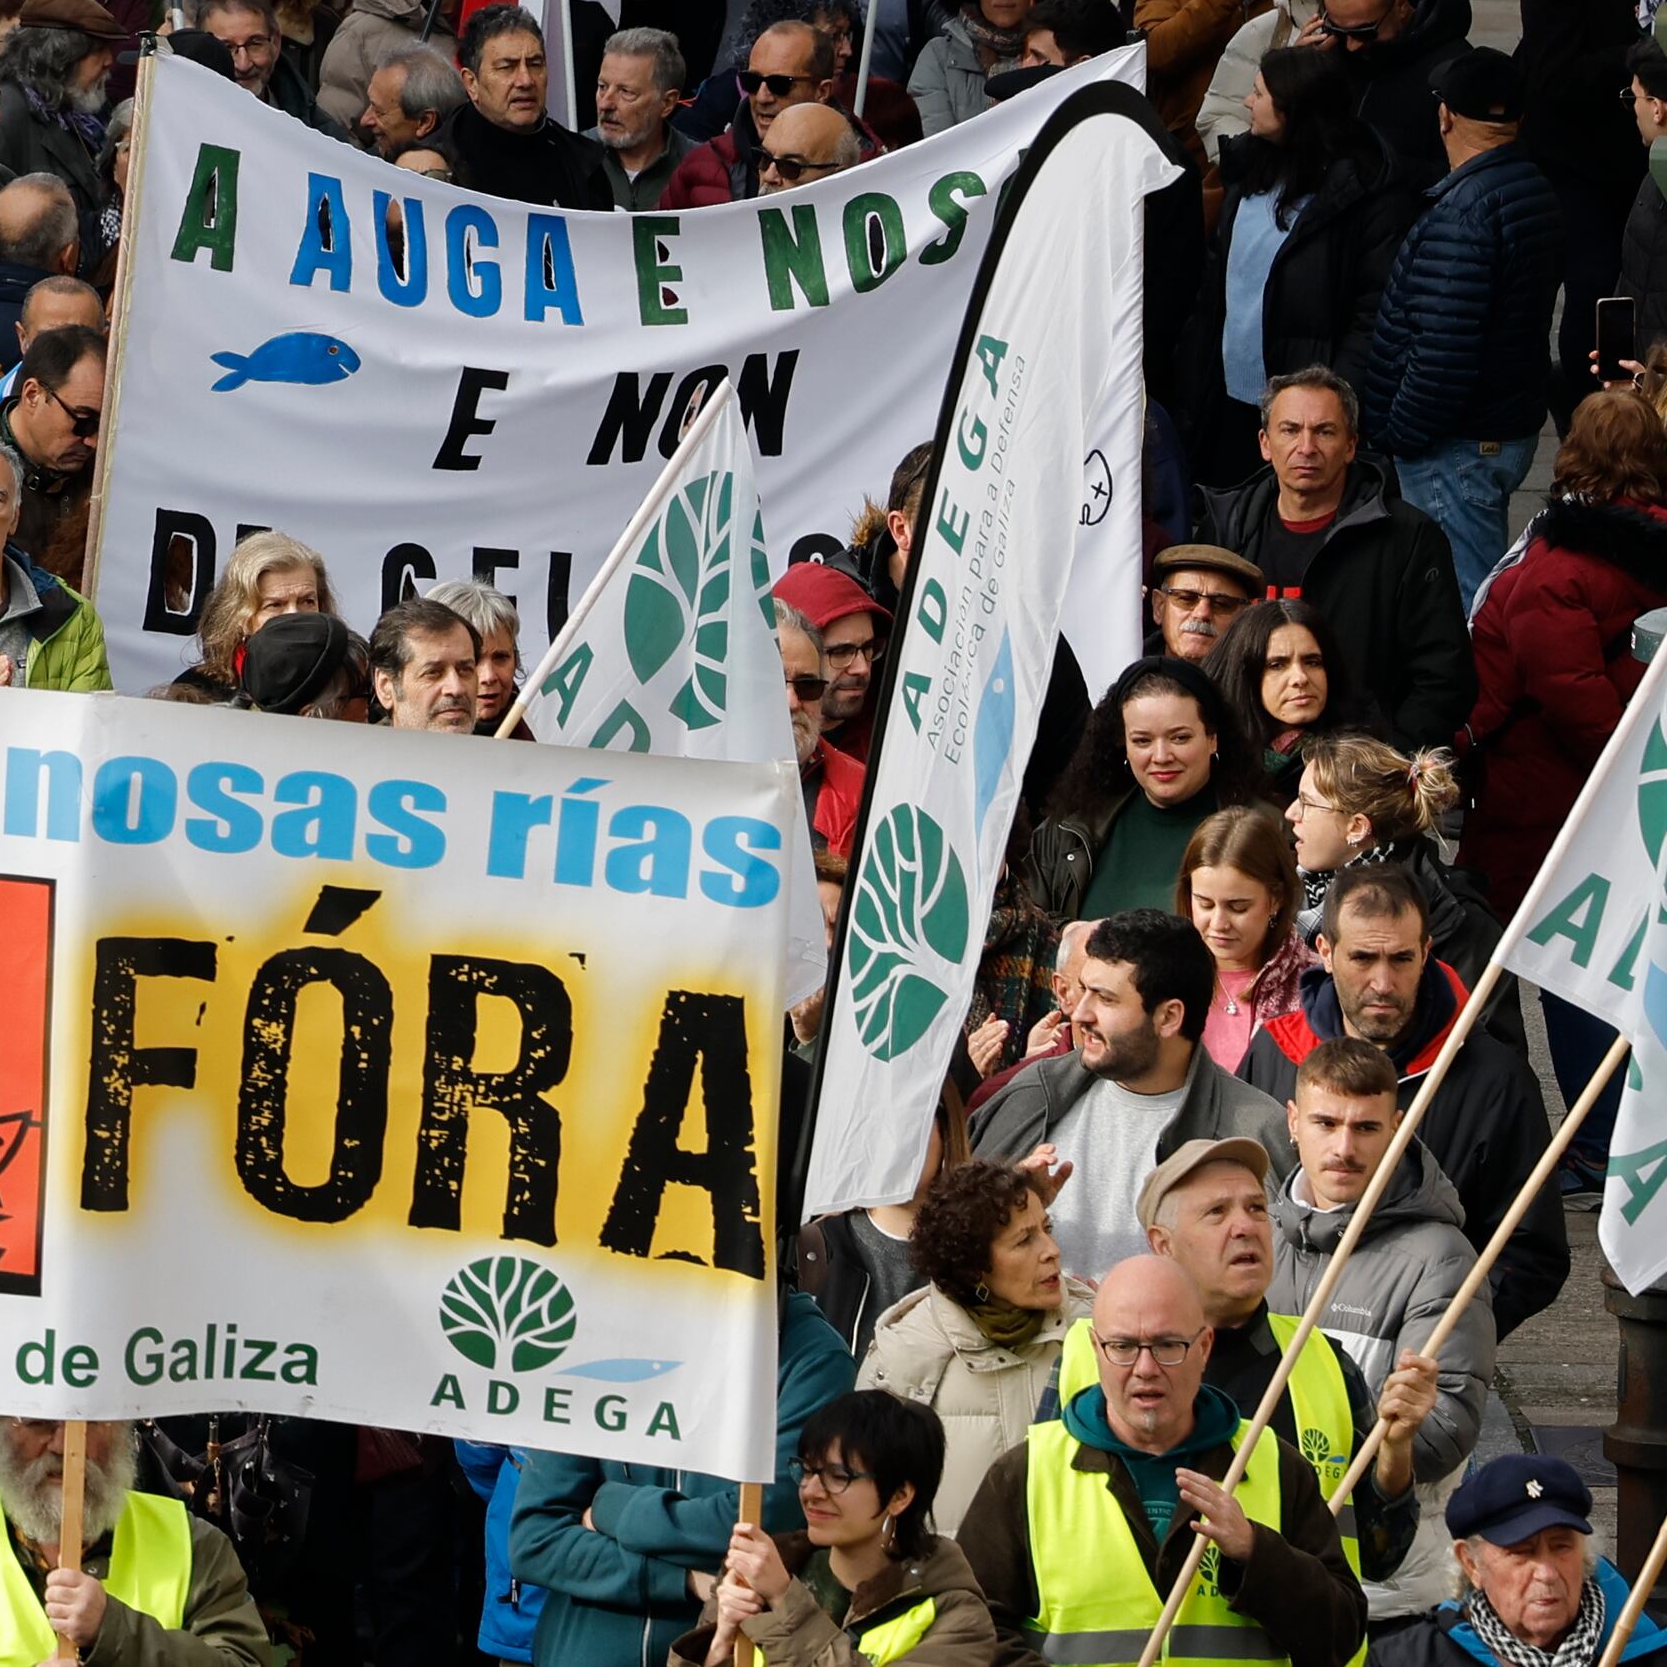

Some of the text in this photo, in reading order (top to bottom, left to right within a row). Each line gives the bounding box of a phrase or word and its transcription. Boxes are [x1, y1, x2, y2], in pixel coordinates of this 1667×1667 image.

[171, 142, 241, 272] A
[288, 171, 582, 327] AUGA
[631, 215, 688, 327] E
[432, 349, 800, 472] E NON
[989, 352, 1027, 476] Defensa
[901, 334, 1009, 736] ADEGA
[967, 512, 995, 583] para
[982, 575, 1001, 616] de
[995, 479, 1018, 571] Galiza
[986, 484, 998, 499] a
[2, 745, 447, 871] nosas
[486, 776, 781, 909] rías
[79, 885, 766, 1283] FÓRA
[15, 1328, 101, 1389] de
[123, 1321, 319, 1388] Galiza
[429, 1372, 684, 1441] ADEGA
